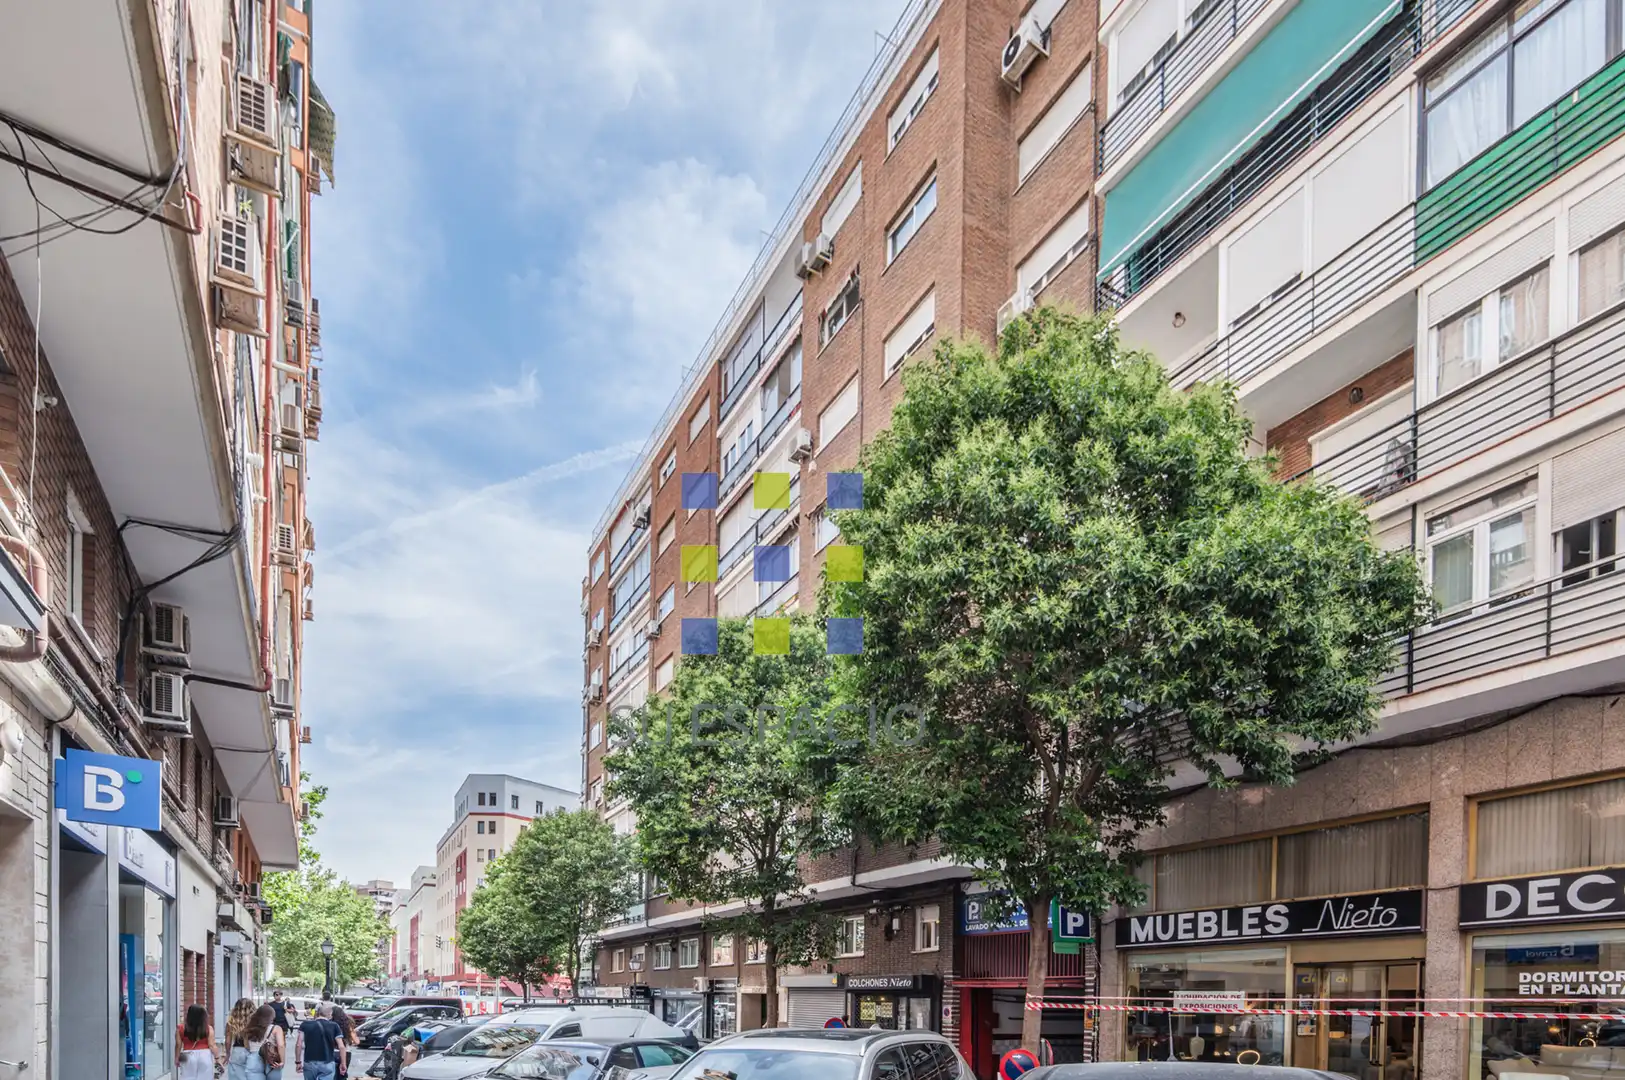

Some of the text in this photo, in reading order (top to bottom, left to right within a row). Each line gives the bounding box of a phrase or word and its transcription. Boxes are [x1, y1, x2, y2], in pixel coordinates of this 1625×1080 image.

[83, 764, 126, 812] B
[1485, 874, 1625, 919] DEC
[965, 923, 989, 932] LAVADO
[1067, 912, 1085, 935] P
[1130, 897, 1398, 943] MUEBLES Nieto
[848, 978, 912, 988] COLCHONES Nieto
[1518, 984, 1544, 995] EN
